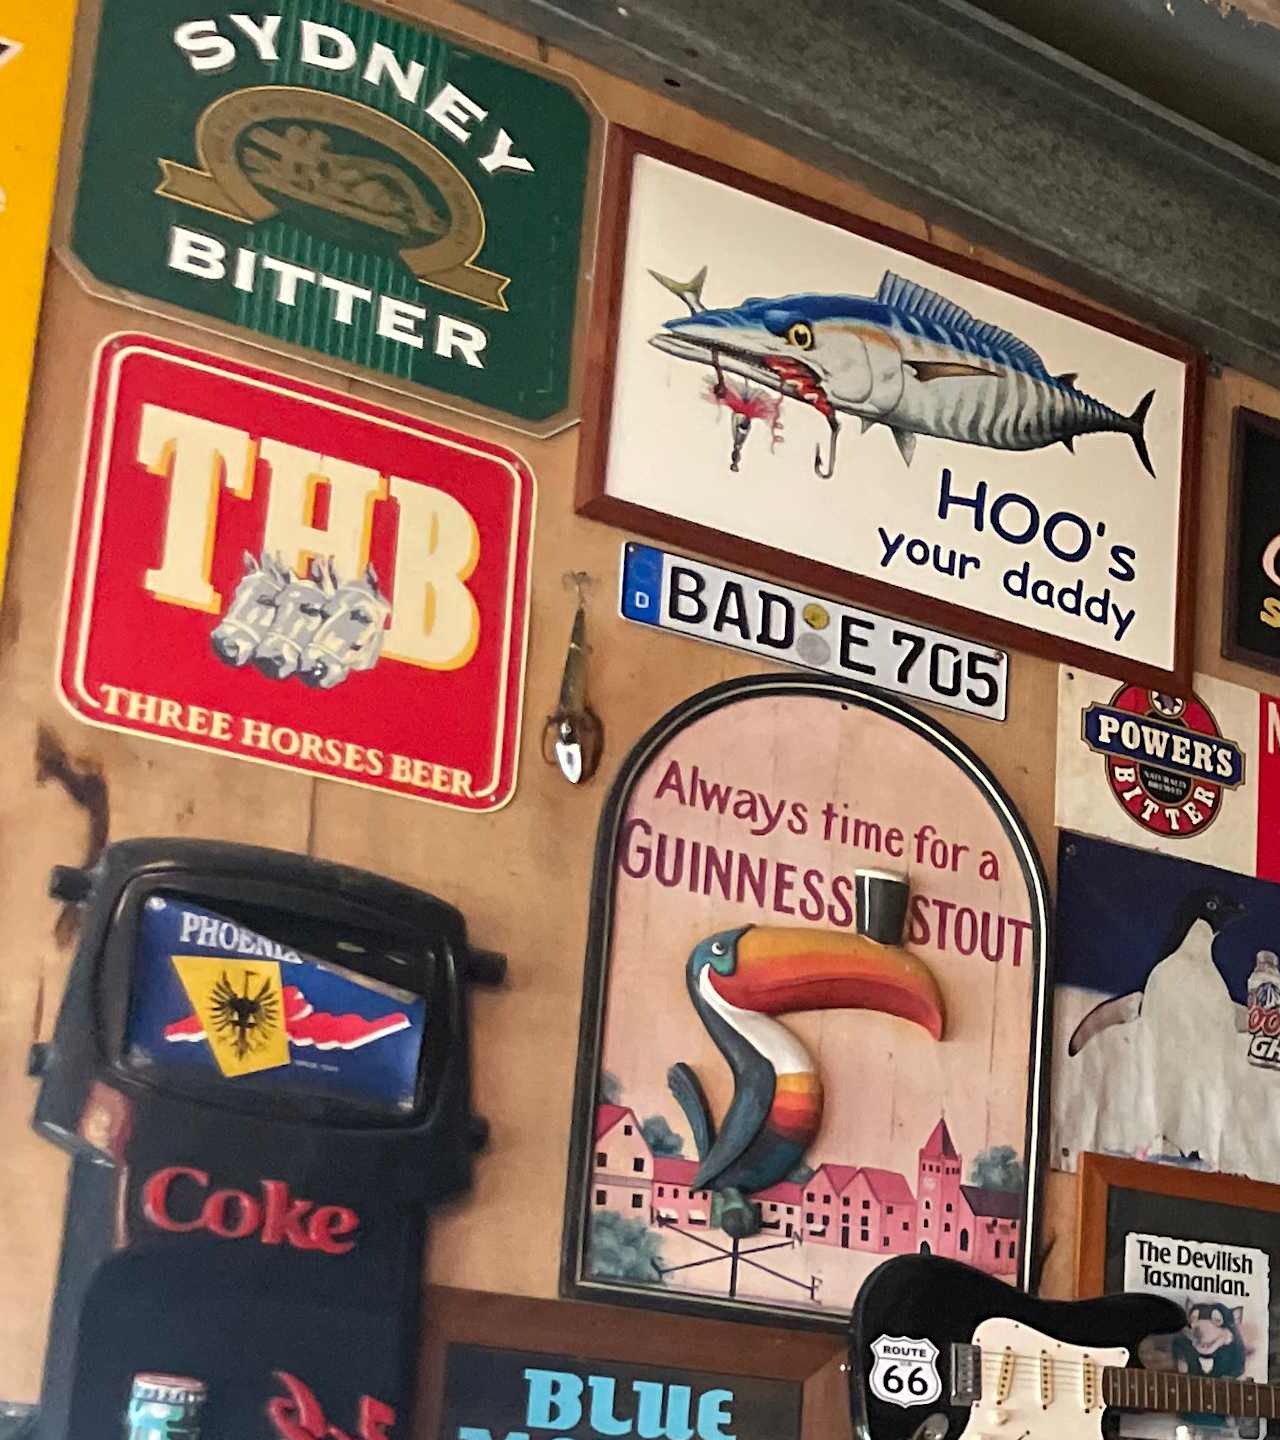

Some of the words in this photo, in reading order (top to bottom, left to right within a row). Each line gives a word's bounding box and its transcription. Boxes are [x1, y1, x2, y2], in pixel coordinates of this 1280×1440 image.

[174, 14, 535, 175] SYDNEY
[168, 226, 487, 369] BITTER
[137, 403, 481, 671] THB
[937, 468, 1137, 583] HOO's
[668, 566, 794, 651] BAD
[839, 618, 875, 676] E
[892, 632, 1000, 708] 705
[877, 527, 980, 581] your
[1003, 561, 1136, 640] daddy
[101, 684, 233, 741] THREE
[241, 719, 383, 775] HORSES
[389, 752, 474, 798] BEER
[1098, 713, 1234, 779] POWER'S
[655, 760, 808, 835] Always
[821, 802, 905, 857] time
[914, 825, 969, 873] for
[979, 851, 1000, 881] a
[620, 818, 855, 928] GUINNESS
[909, 894, 1033, 967] STOUT
[142, 1167, 360, 1255] Coke
[1136, 1240, 1171, 1266] The
[1177, 1246, 1253, 1276] Devilish
[1141, 1265, 1250, 1297] Tasmanian.
[882, 1345, 927, 1358] ROUTE
[883, 1366, 928, 1396] 66
